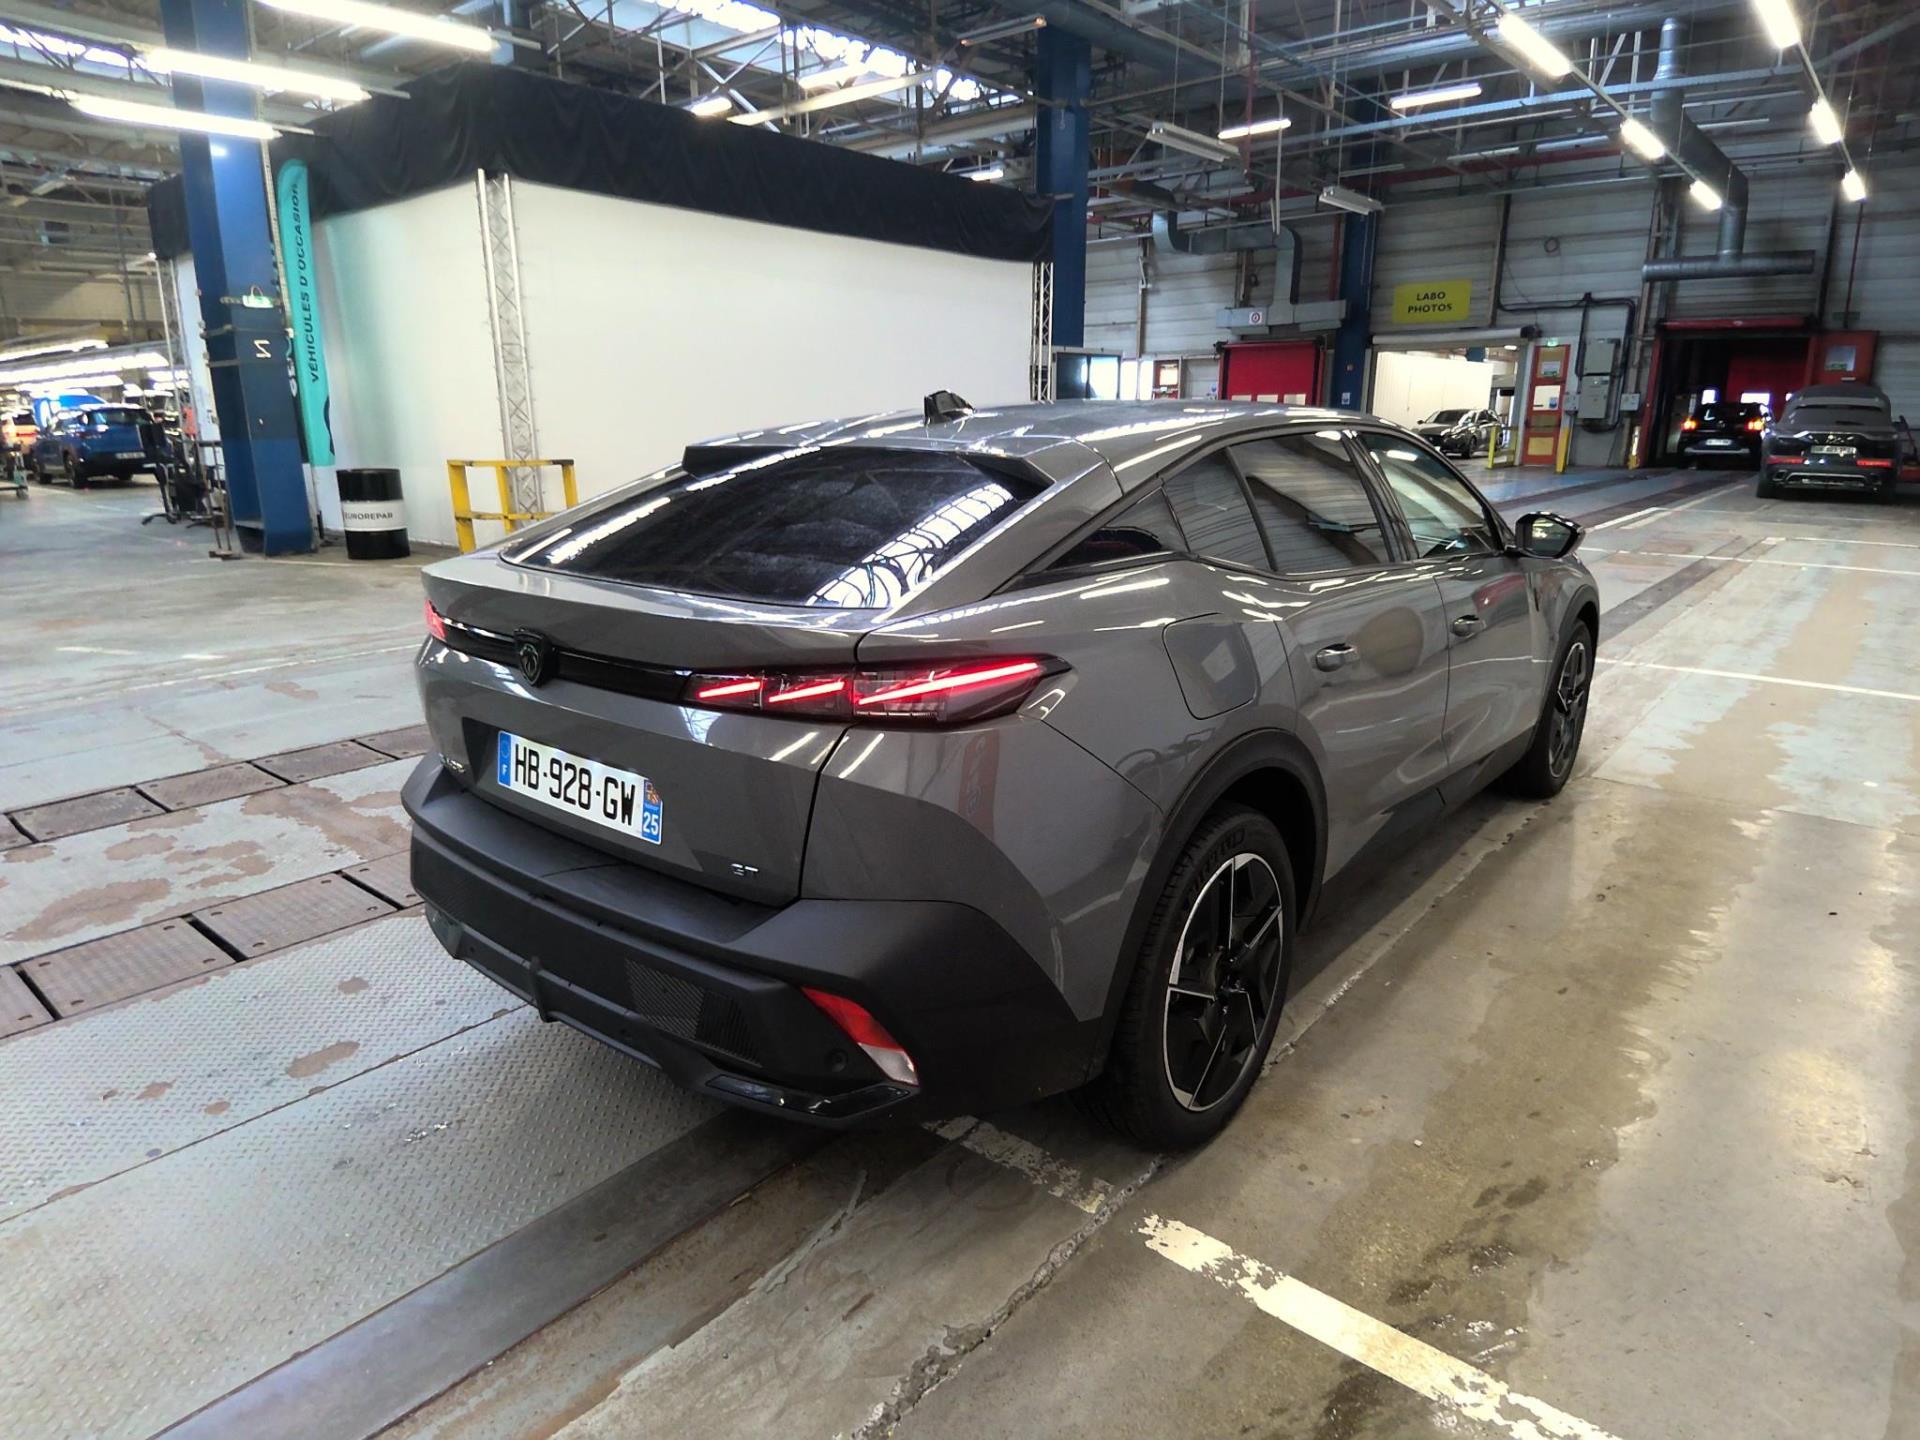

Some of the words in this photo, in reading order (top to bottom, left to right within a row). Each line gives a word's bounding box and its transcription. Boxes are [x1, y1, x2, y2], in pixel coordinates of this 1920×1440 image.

[1416, 291, 1446, 301] LABO
[1408, 303, 1453, 314] PHOTOS
[514, 743, 636, 826] HB-928-GW
[642, 811, 659, 836] 25
